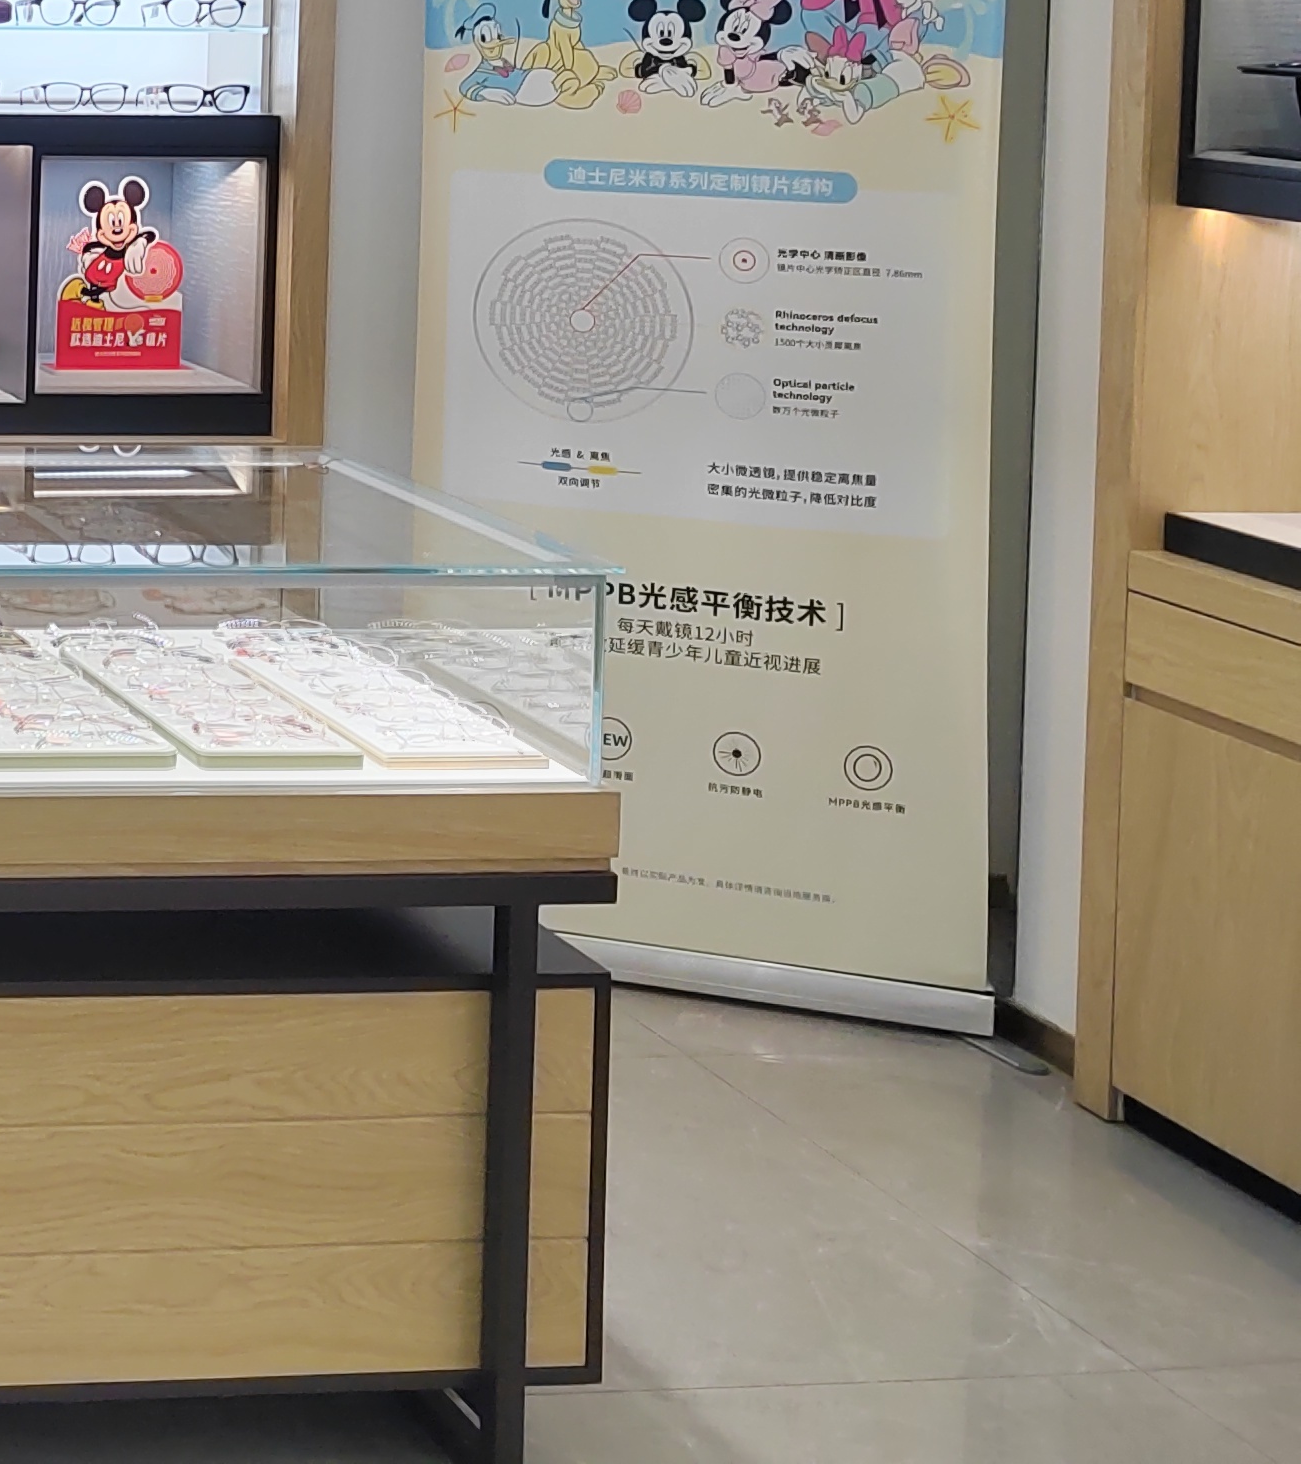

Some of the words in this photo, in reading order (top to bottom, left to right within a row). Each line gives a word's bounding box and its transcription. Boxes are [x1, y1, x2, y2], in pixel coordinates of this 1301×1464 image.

[567, 166, 834, 198] 迪士尼米奇系列定制镜片结构
[775, 310, 834, 322] Rhinoceros
[837, 314, 878, 324] defocus
[775, 322, 835, 336] technology
[773, 378, 812, 389] Optical
[815, 381, 855, 392] particle
[772, 390, 833, 404] technology
[550, 447, 572, 460] 光感
[576, 449, 585, 460] &
[557, 476, 601, 489] 双向调节
[617, 617, 753, 647] 每天戴镜12小时
[604, 635, 822, 676] 延缓青少年儿童近视进展
[603, 732, 628, 747] EW
